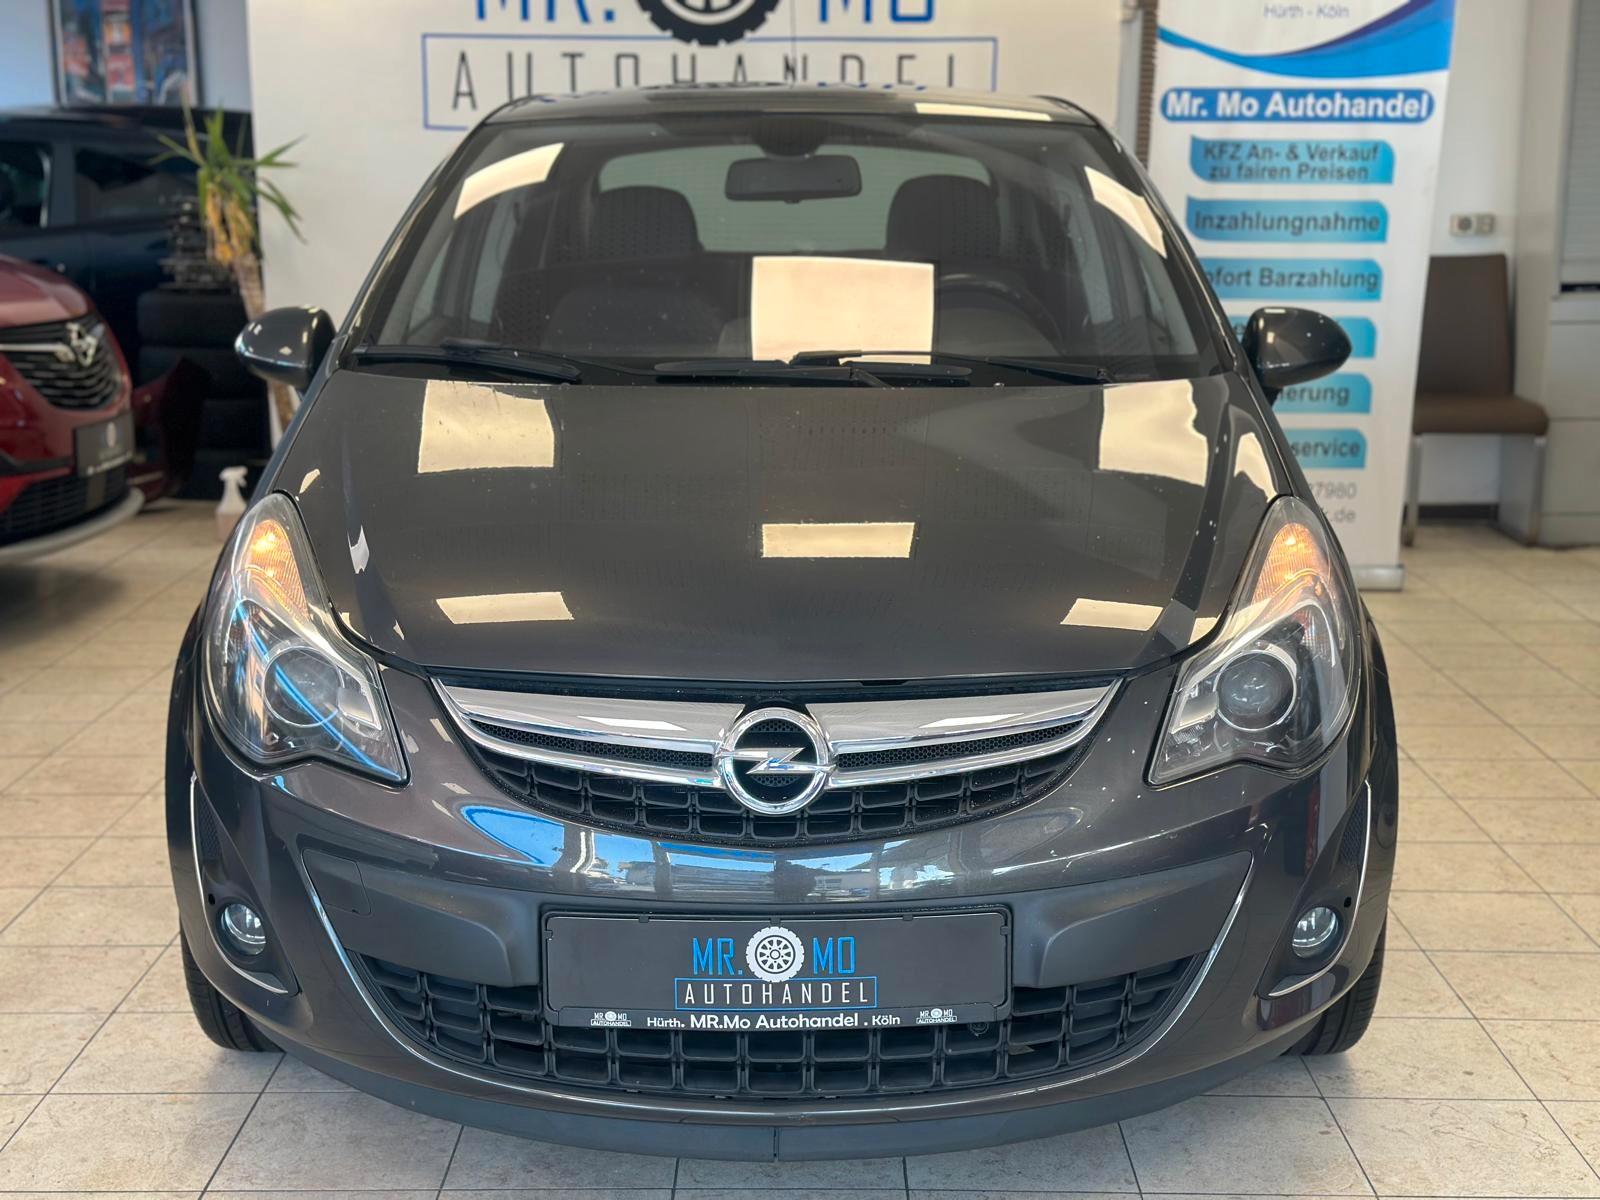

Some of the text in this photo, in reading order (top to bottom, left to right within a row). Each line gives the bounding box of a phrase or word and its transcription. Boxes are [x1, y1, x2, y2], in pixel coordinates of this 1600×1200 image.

[1317, 3, 1350, 18] Köln
[1166, 91, 1429, 118] Mr. Mo Autohandel
[1204, 144, 1379, 161] KFZ An- & Verkauf
[1209, 163, 1369, 181] zu fairen Preisen
[1195, 211, 1380, 236] Inzahlungnahme
[1206, 267, 1379, 292] ofort Barzahlung
[1291, 437, 1360, 457] service
[1309, 482, 1357, 499] 7980
[692, 937, 856, 975] MR. MO
[685, 982, 868, 1004] AUTOHANDEL
[647, 1017, 685, 1028] Hürth.
[690, 1014, 751, 1029] MR.Mo
[756, 1013, 858, 1029] Autohandel
[872, 1015, 901, 1026] Köln
